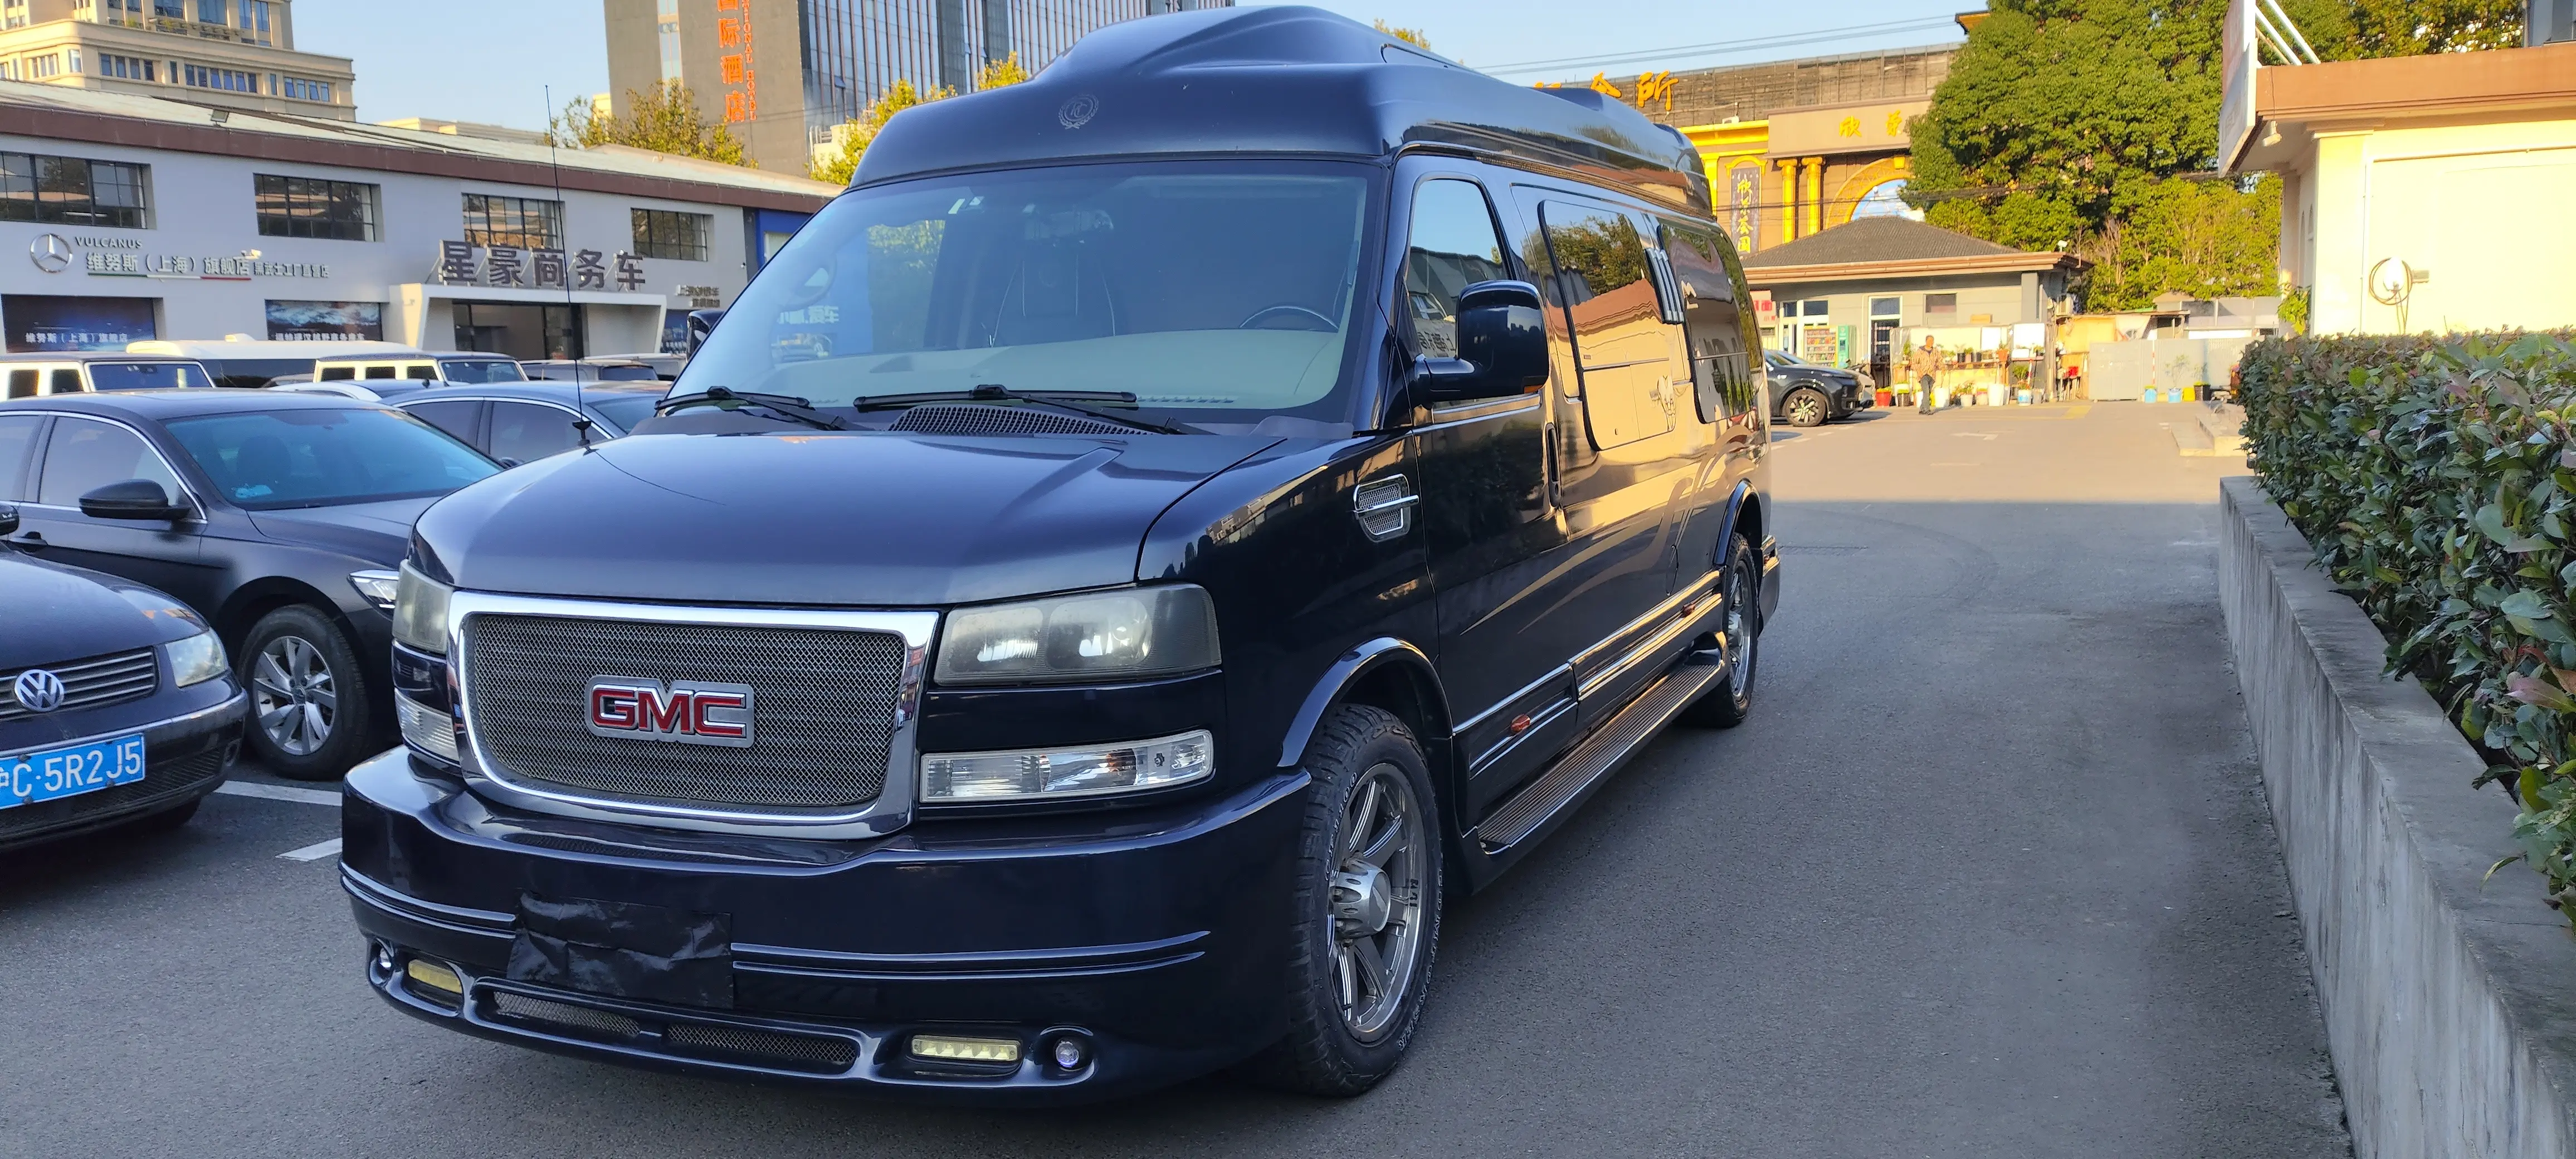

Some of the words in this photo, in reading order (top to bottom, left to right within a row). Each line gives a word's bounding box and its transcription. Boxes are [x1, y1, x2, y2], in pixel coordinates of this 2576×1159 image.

[741, 0, 753, 64] TIONAL
[747, 70, 757, 120] HOTEL
[75, 236, 143, 249] VULCANUS
[439, 240, 646, 290] 星豪商务车
[592, 684, 747, 738] GMC
